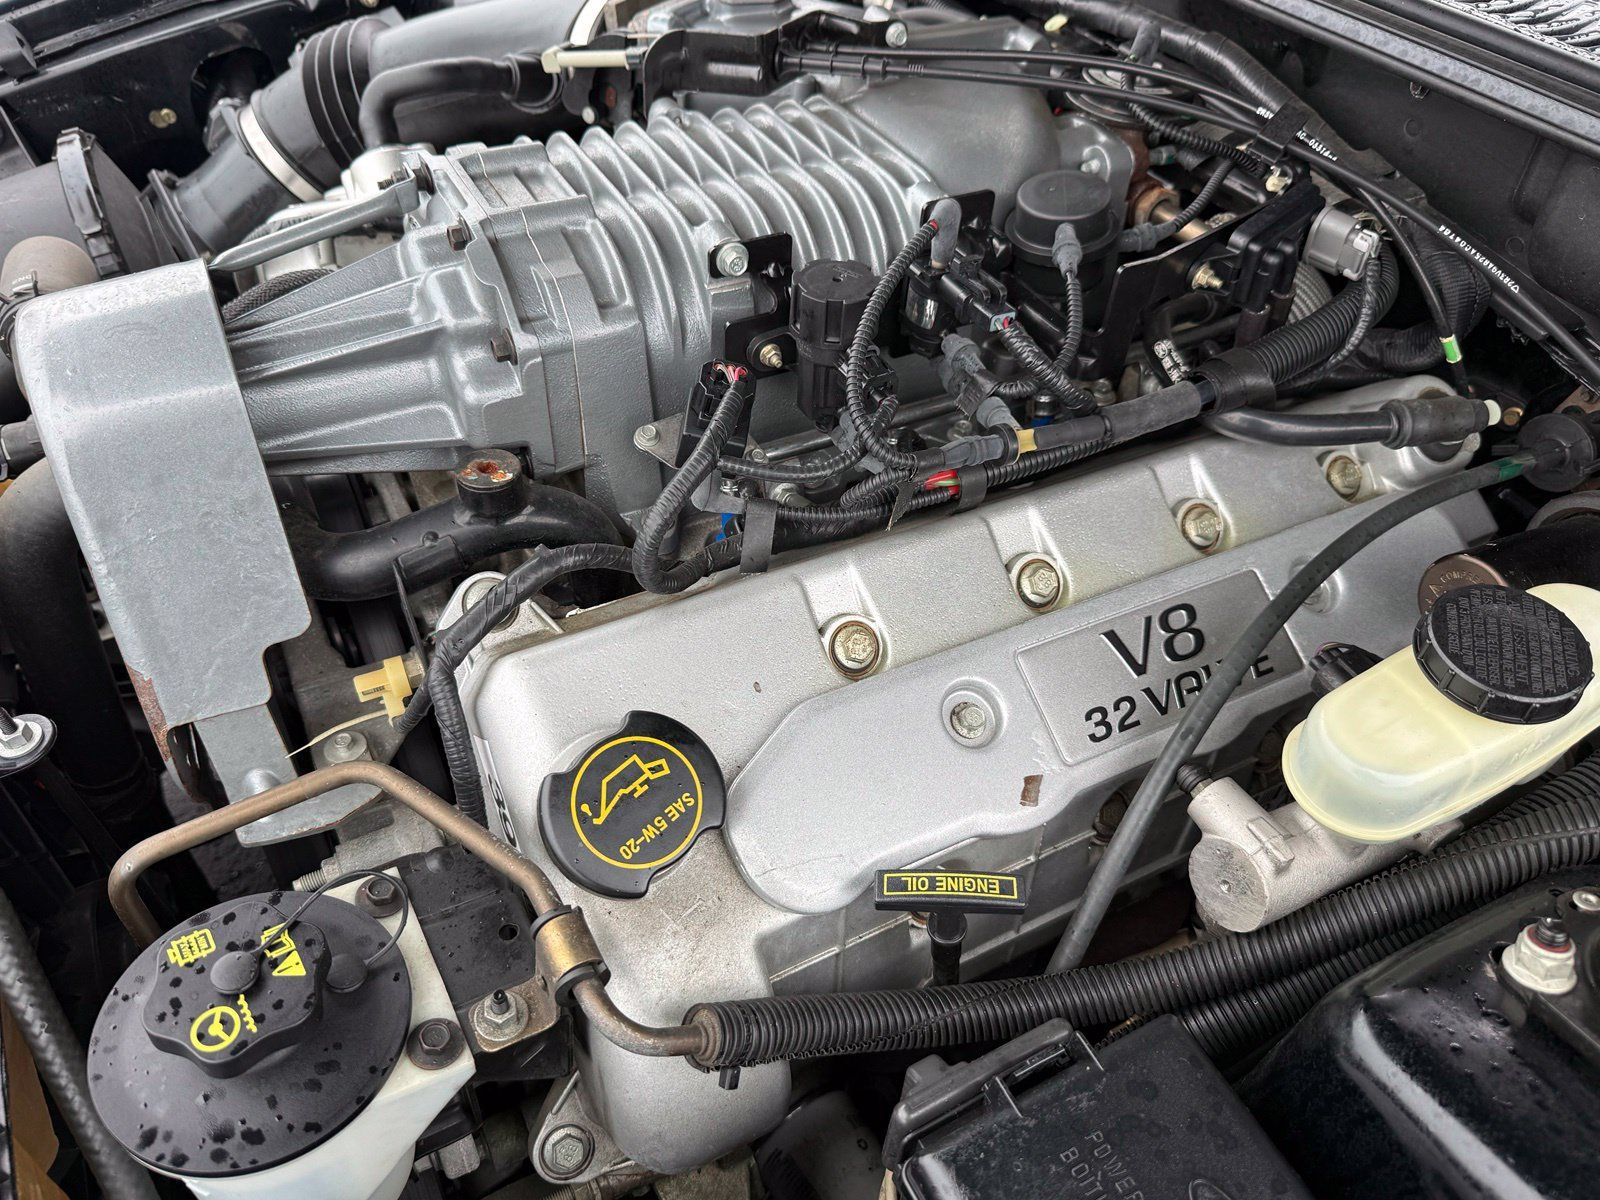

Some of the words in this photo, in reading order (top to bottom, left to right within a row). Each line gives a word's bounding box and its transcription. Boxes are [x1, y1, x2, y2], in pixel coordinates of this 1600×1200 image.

[1100, 602, 1205, 679] V8
[1508, 600, 1528, 684] AVTISSEMENT
[1084, 696, 1141, 743] 32
[1141, 654, 1275, 716] VAE
[664, 792, 695, 822] SAE
[619, 816, 668, 860] 5W-20
[901, 876, 929, 892] OIL
[936, 877, 1000, 894] ENGINE
